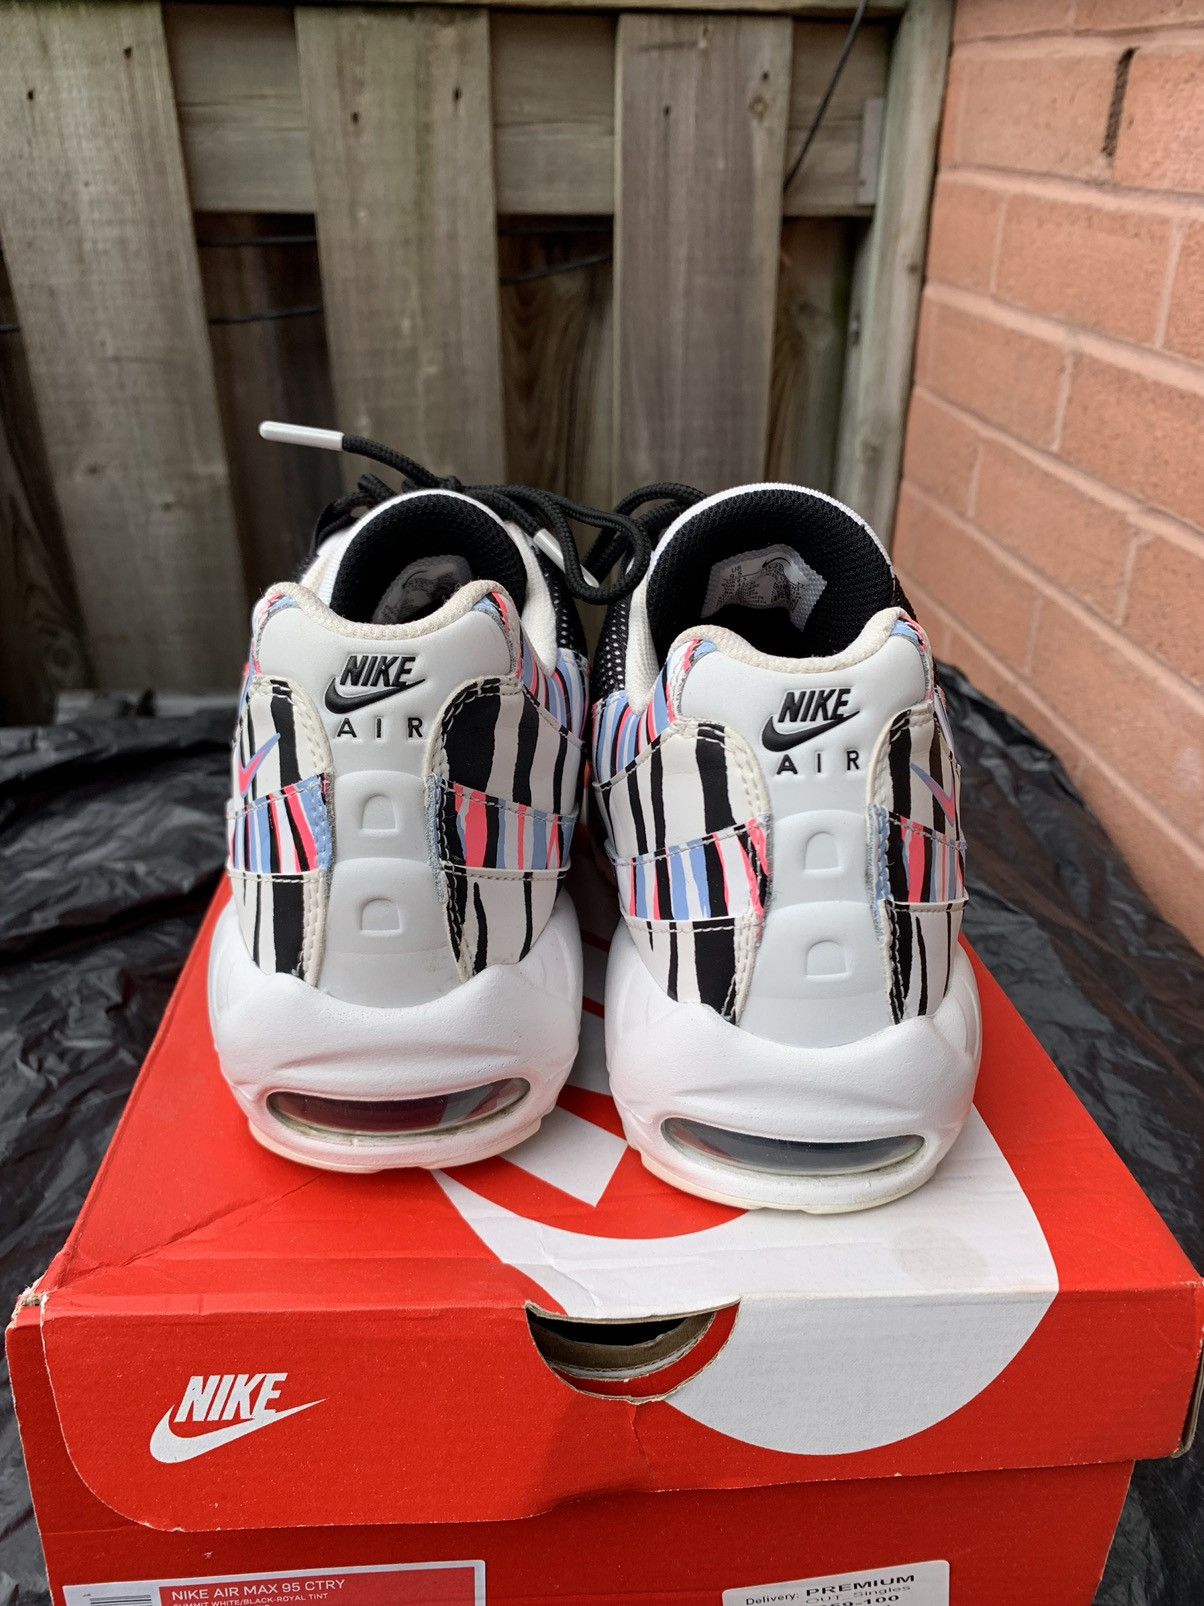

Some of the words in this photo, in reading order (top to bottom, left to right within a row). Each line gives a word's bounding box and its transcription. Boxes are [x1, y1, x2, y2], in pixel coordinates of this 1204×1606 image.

[339, 655, 416, 688] NIKE
[777, 688, 851, 723] NIKE
[336, 717, 423, 738] AIR
[776, 750, 860, 775] AIR
[172, 1372, 289, 1423] NIKE
[171, 1588, 208, 1600] NIKE
[213, 1586, 240, 1598] AIR
[244, 1583, 278, 1596] MAX
[282, 1582, 300, 1593] 95
[304, 1579, 346, 1591] CTRY
[309, 1592, 328, 1600] TINT
[806, 1575, 915, 1597] PREMIUM
[745, 1593, 800, 1606] Delivery:
